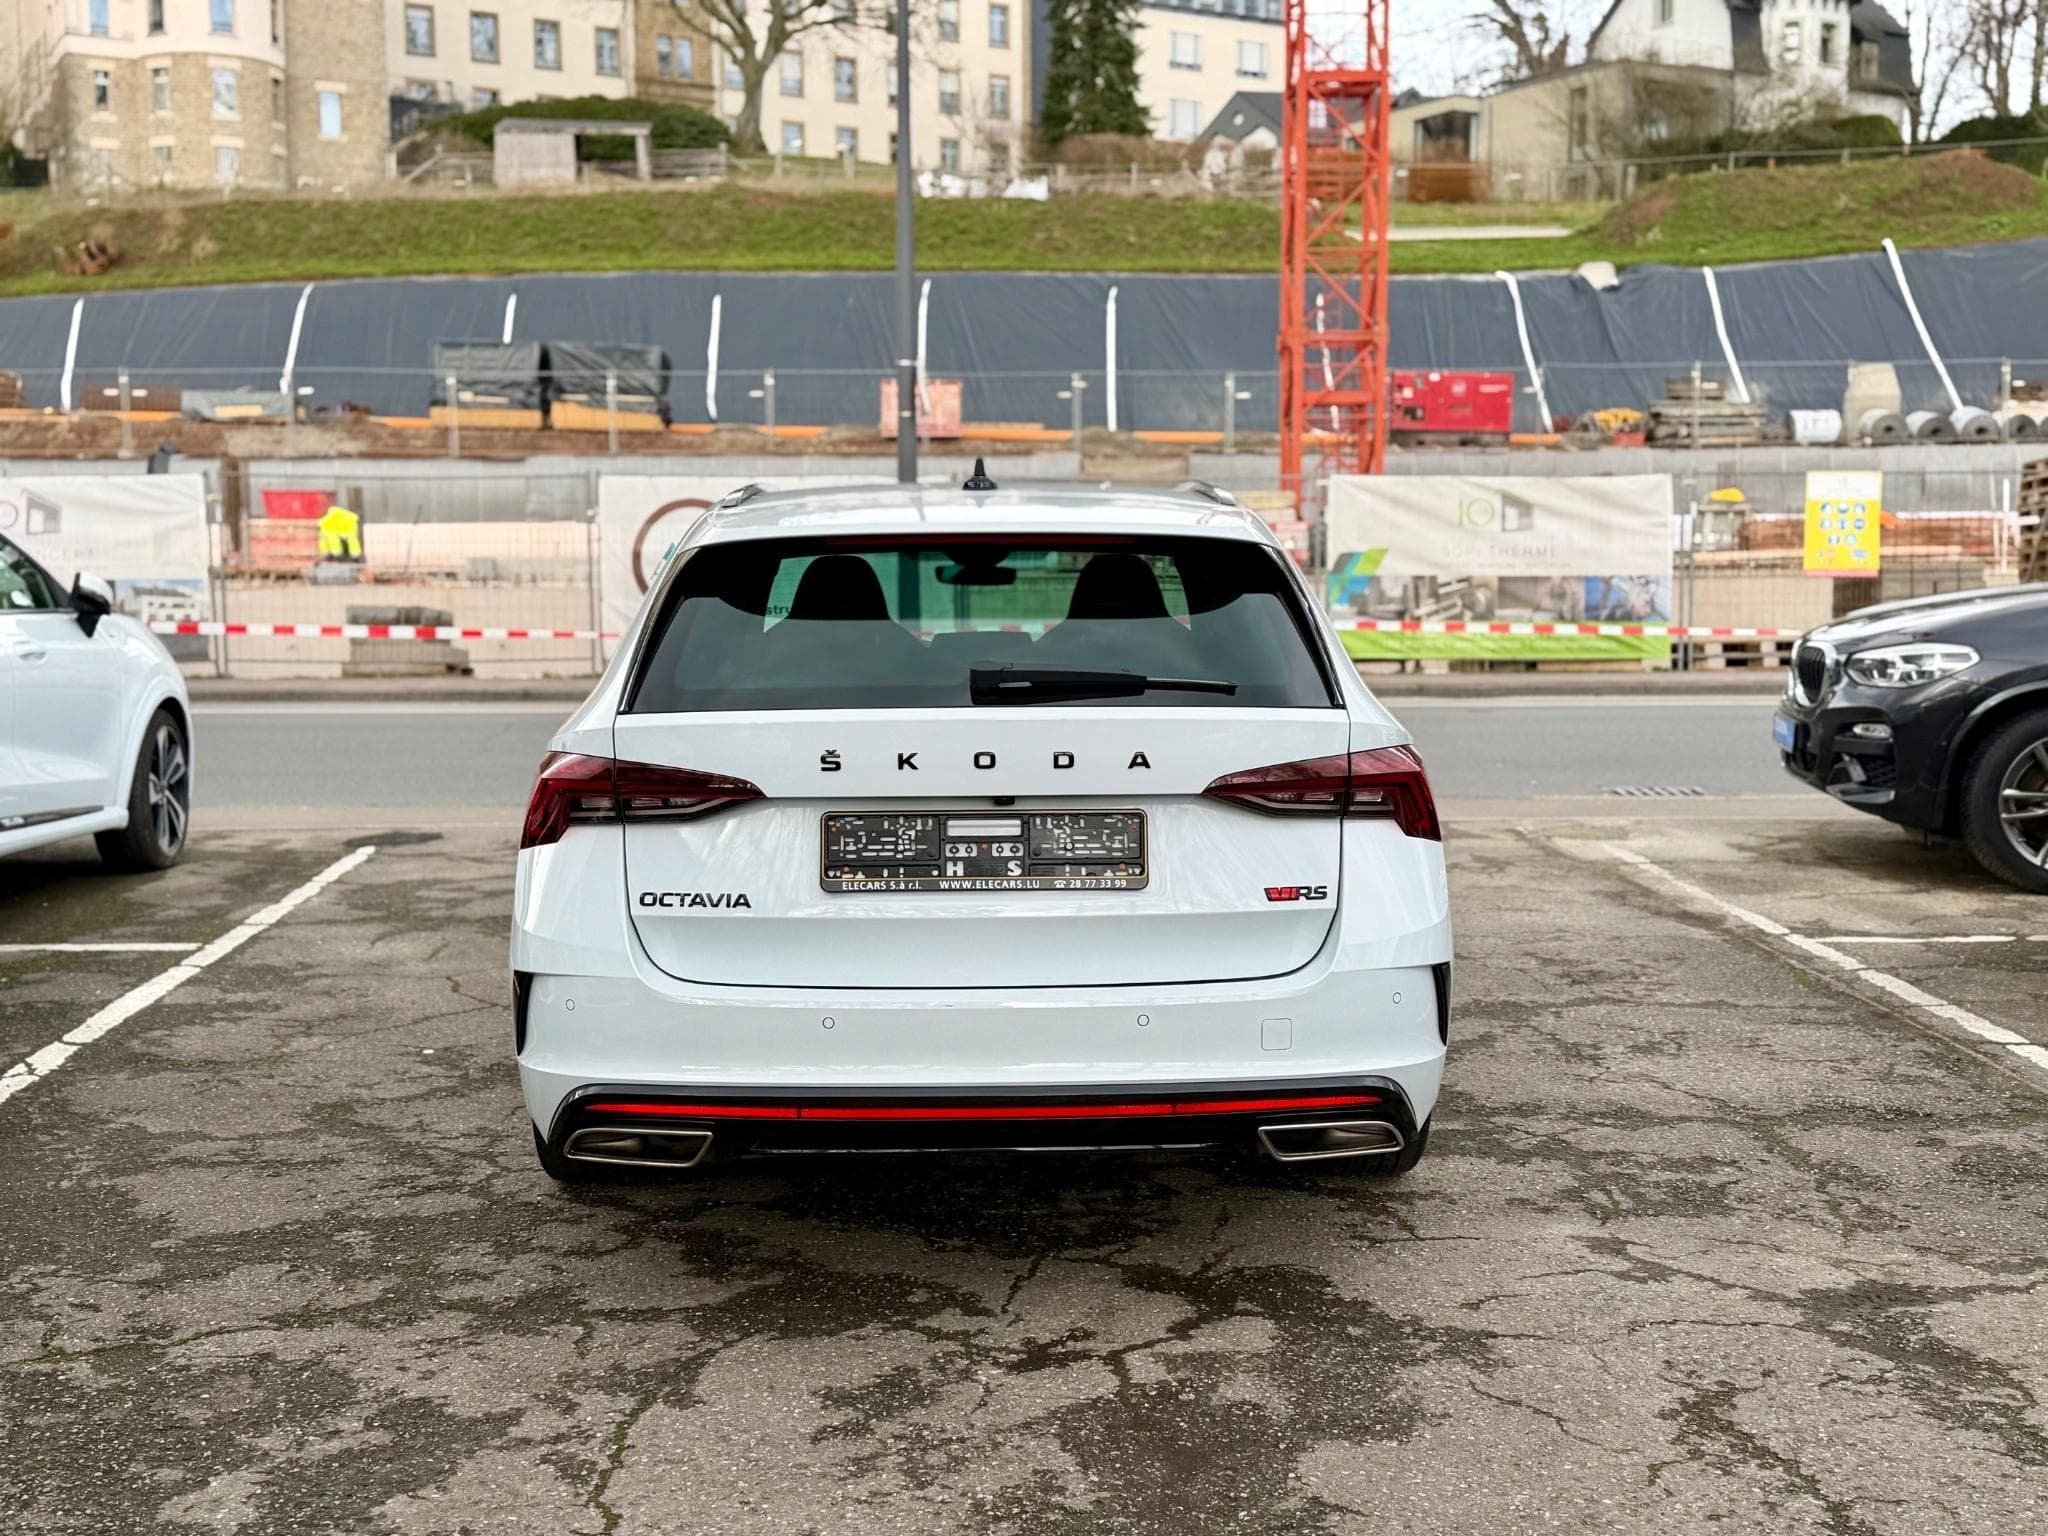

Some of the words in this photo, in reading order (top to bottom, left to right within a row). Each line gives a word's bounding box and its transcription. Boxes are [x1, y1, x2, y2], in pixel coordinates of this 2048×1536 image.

[820, 749, 1151, 772] ŠKODA
[842, 881, 886, 890] ELECARS
[939, 880, 1040, 889] WWW.ELECARS.LU
[1070, 880, 1081, 888] 28
[1085, 880, 1096, 888] 77
[1100, 880, 1111, 888] 33
[1115, 879, 1127, 888] 99
[639, 891, 752, 908] OCTAVIA
